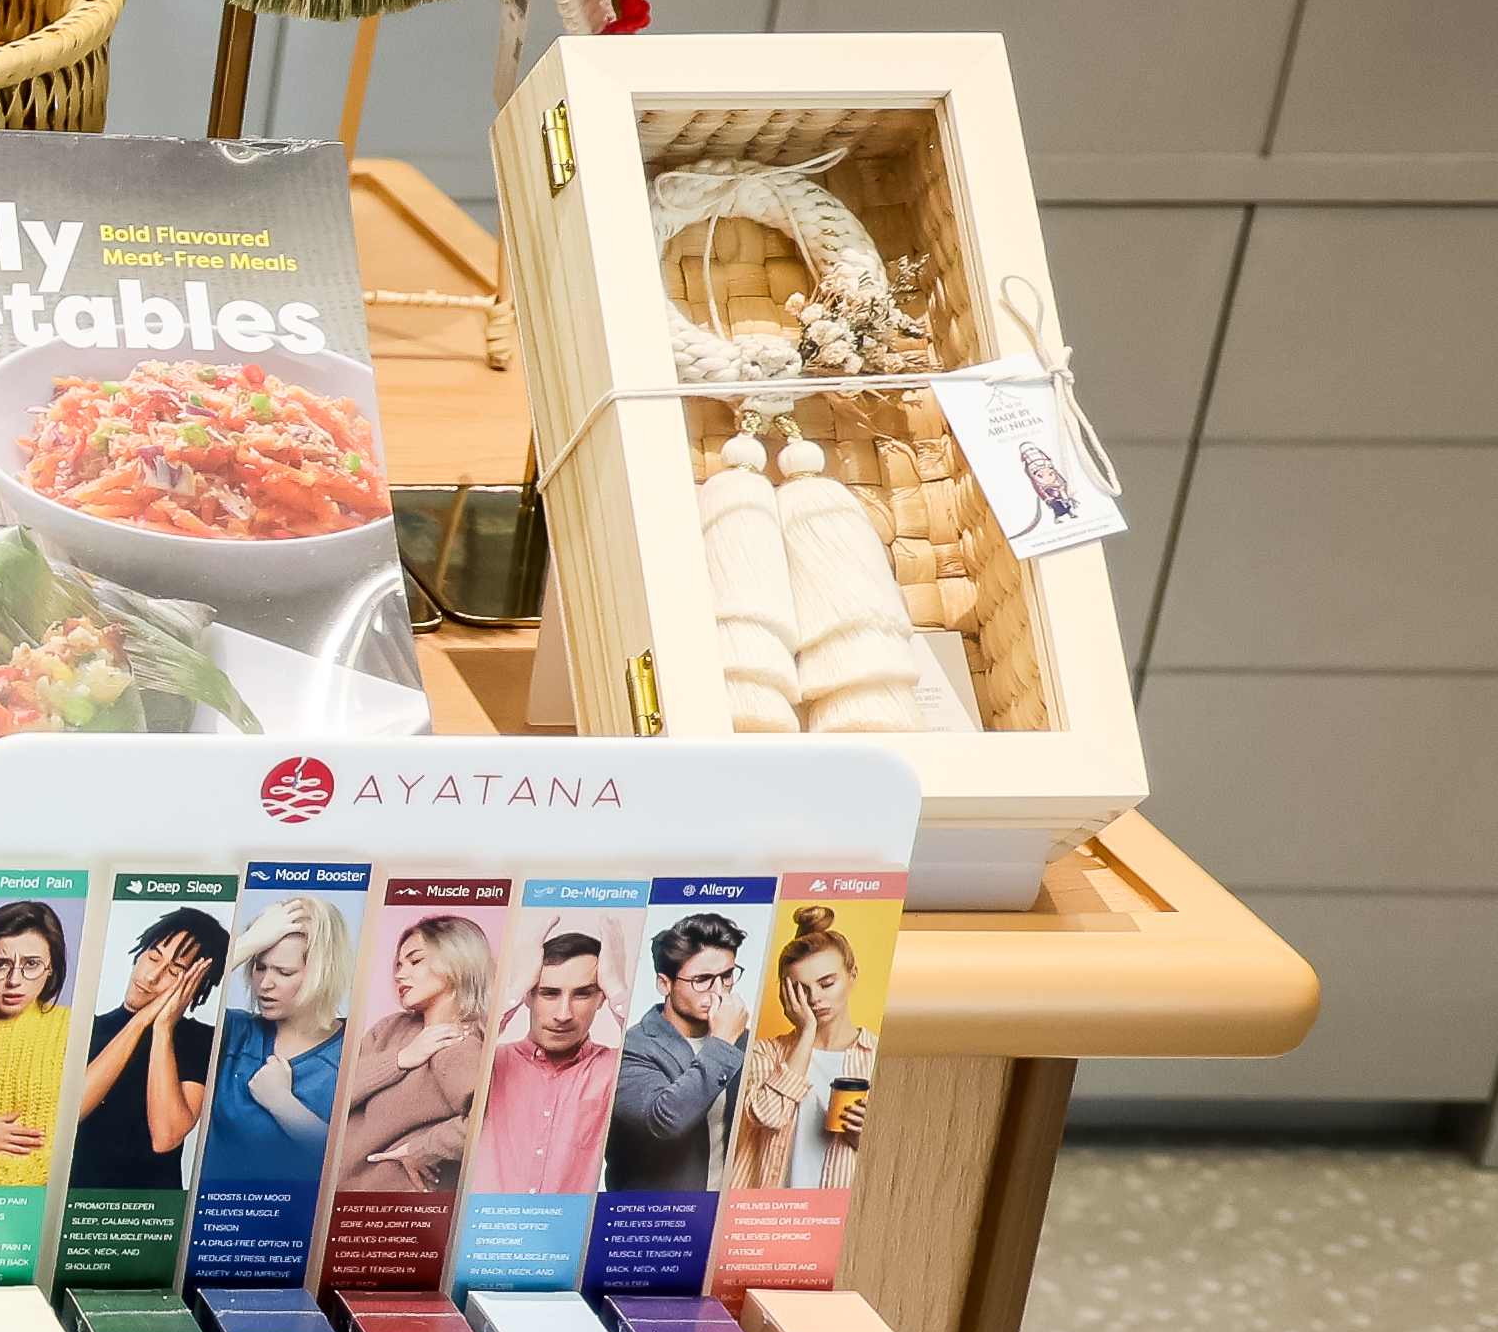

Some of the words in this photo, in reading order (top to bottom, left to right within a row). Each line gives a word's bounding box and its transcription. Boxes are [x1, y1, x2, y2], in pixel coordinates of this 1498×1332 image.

[99, 223, 151, 245] Bold
[156, 225, 270, 248] Flavoured
[102, 248, 225, 271] Meat-Free
[230, 250, 298, 273] Meals
[351, 770, 624, 811] AYATANA
[0, 876, 40, 890] Period
[45, 876, 73, 889] Pain
[275, 868, 310, 882] Mood
[315, 868, 366, 883] Booster
[146, 880, 181, 896] Deep
[186, 880, 223, 896] Sleep
[426, 884, 471, 898] Muscle
[475, 885, 505, 901] pain
[560, 885, 639, 902] De-Migraine
[699, 882, 745, 900] Allergy
[832, 877, 881, 894] Fatigue
[74, 1202, 120, 1210] PROMOTES
[122, 1202, 155, 1211] DEEPER
